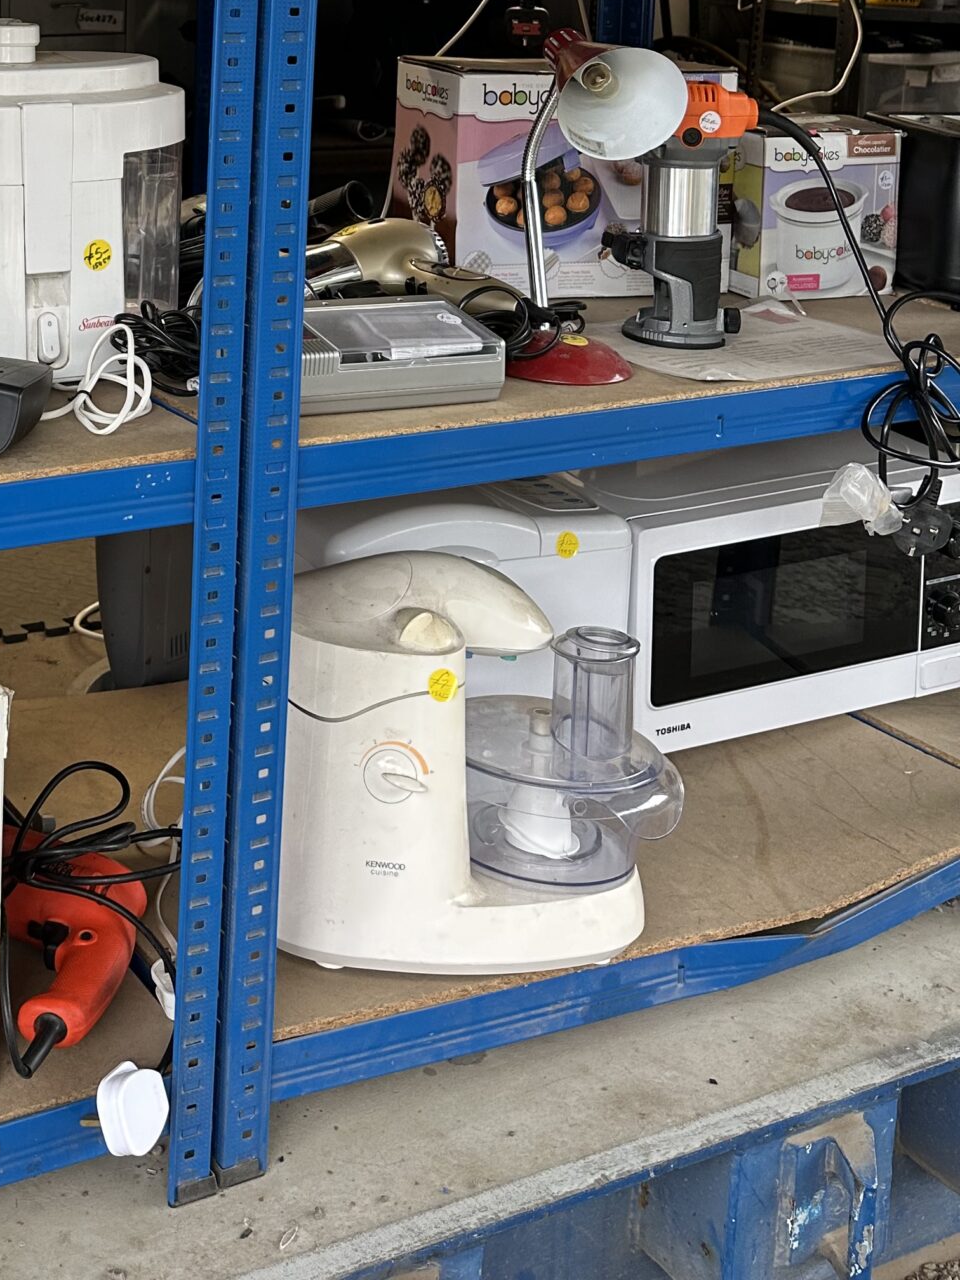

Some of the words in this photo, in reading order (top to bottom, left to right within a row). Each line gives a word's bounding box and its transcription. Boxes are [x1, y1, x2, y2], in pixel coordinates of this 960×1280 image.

[405, 72, 449, 100] babycakes
[482, 83, 551, 114] babyc
[853, 146, 891, 154] Chocolatier
[655, 722, 691, 736] TOSHIBA
[365, 860, 406, 870] KENWOOD
